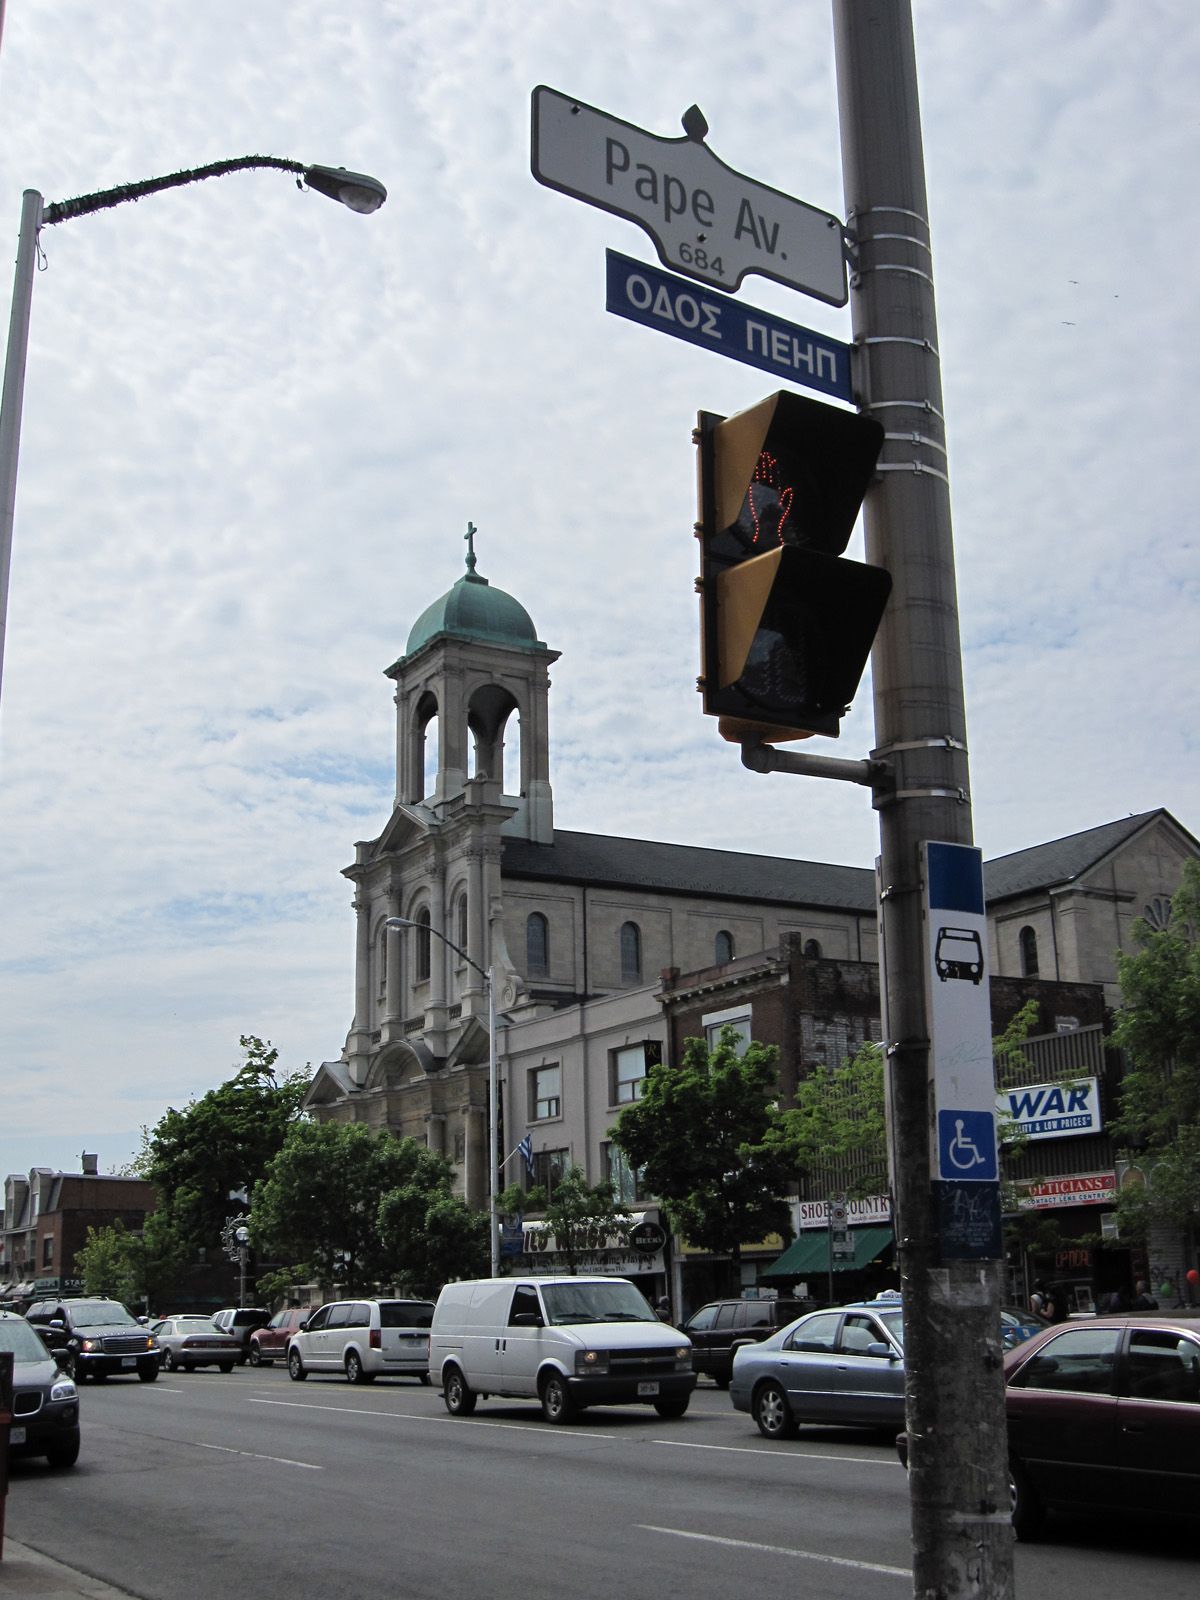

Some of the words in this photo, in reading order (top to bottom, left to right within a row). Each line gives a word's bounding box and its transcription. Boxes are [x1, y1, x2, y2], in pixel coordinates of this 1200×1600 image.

[605, 136, 715, 228] Pape
[734, 198, 788, 261] Av.
[678, 241, 725, 276] 684
[625, 274, 722, 339] ΟΔΟΣ
[746, 319, 838, 383] ΠΕΗΠ
[1008, 1085, 1089, 1120] WAR
[1044, 1120, 1058, 1131] LOW
[1028, 1178, 1103, 1196] OPTICIANS
